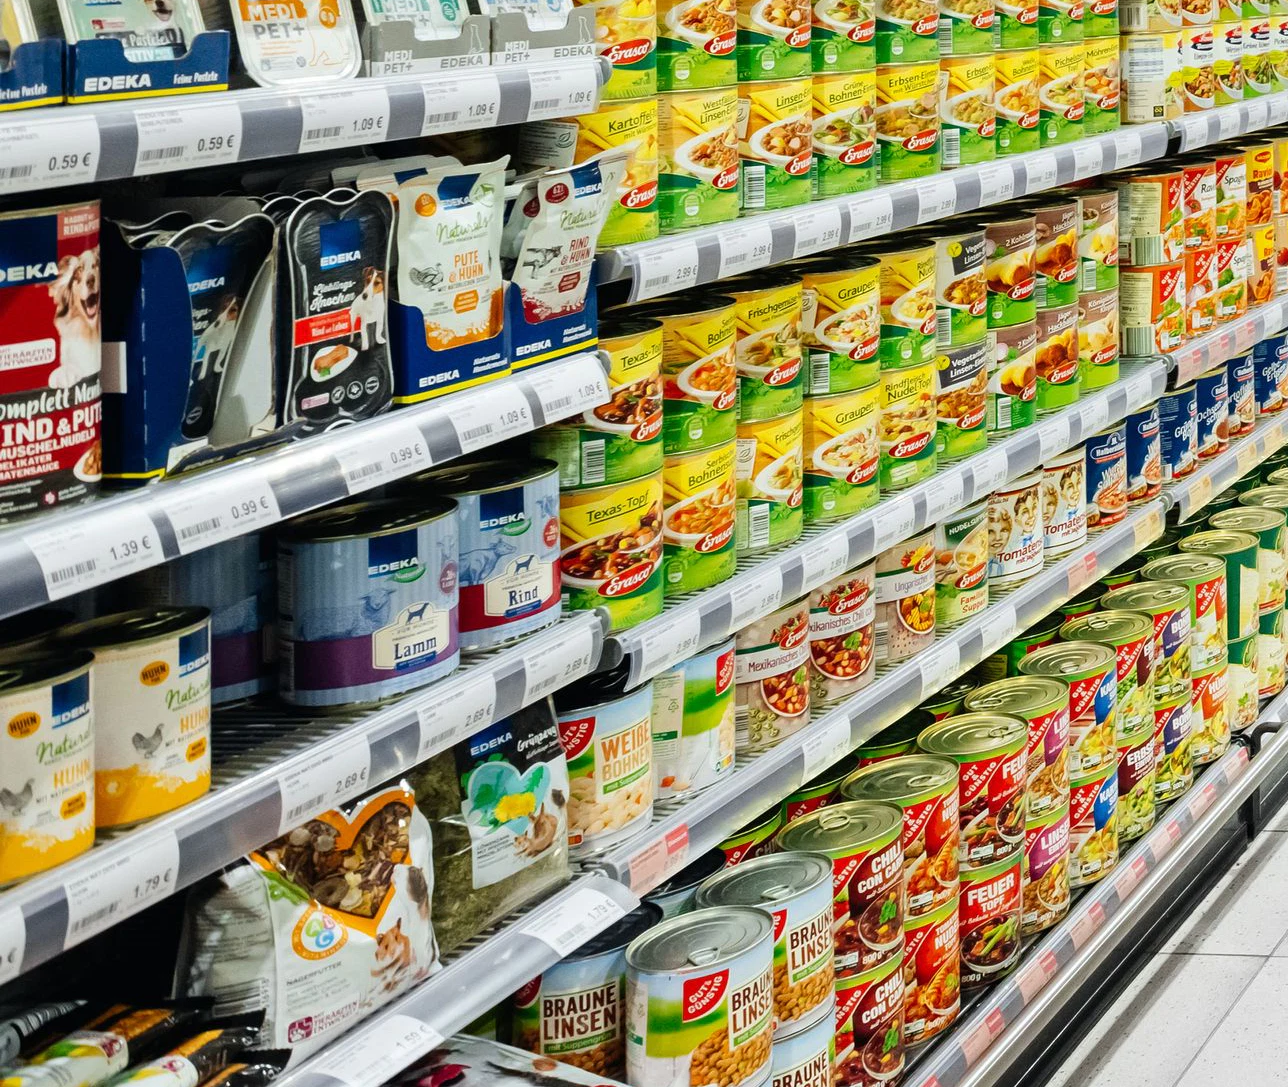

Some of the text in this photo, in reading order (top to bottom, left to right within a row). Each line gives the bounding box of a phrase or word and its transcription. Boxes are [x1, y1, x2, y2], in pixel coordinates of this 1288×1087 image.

[249, 3, 297, 22] MEDI
[384, 50, 413, 62] MEDI
[504, 41, 530, 52] MEDI
[504, 45, 593, 63] PET+ EDEKA
[609, 42, 650, 63] Erasco
[384, 55, 484, 74] PET+ EDEKA
[568, 91, 592, 104] 1.09 €
[468, 102, 496, 117] 1.09 €
[353, 116, 383, 132] 1.09 €
[197, 134, 235, 152] 0.59 €
[907, 129, 937, 150] Erasco
[48, 153, 91, 171] 0.59 €
[569, 236, 590, 252] RIND
[321, 250, 362, 266] EDEKA
[454, 251, 479, 268] PUTE
[516, 339, 552, 356] EDEKA
[419, 369, 460, 388] EDEKA
[885, 372, 925, 393] Rindfleisch
[390, 444, 422, 464] 0.99 €
[894, 434, 929, 456] Erasco
[231, 496, 269, 519] 0.99 €
[586, 490, 650, 522] Texas-Topf
[479, 512, 526, 531] EDEKA
[109, 537, 151, 560] 1.39 €
[368, 557, 419, 578] EDEKA
[605, 564, 652, 595] Erasco
[508, 585, 539, 604] Rind
[834, 590, 866, 612] Erasco
[394, 637, 437, 660] Lamm
[1072, 681, 1088, 699] GUT
[470, 727, 558, 756] EDEKA Grünzeug
[962, 764, 979, 781] GUT
[968, 873, 1015, 906] FEUER
[981, 896, 1005, 912] TOPF
[543, 984, 615, 1017] BRAUNE
[543, 1010, 617, 1040] LINSEN
